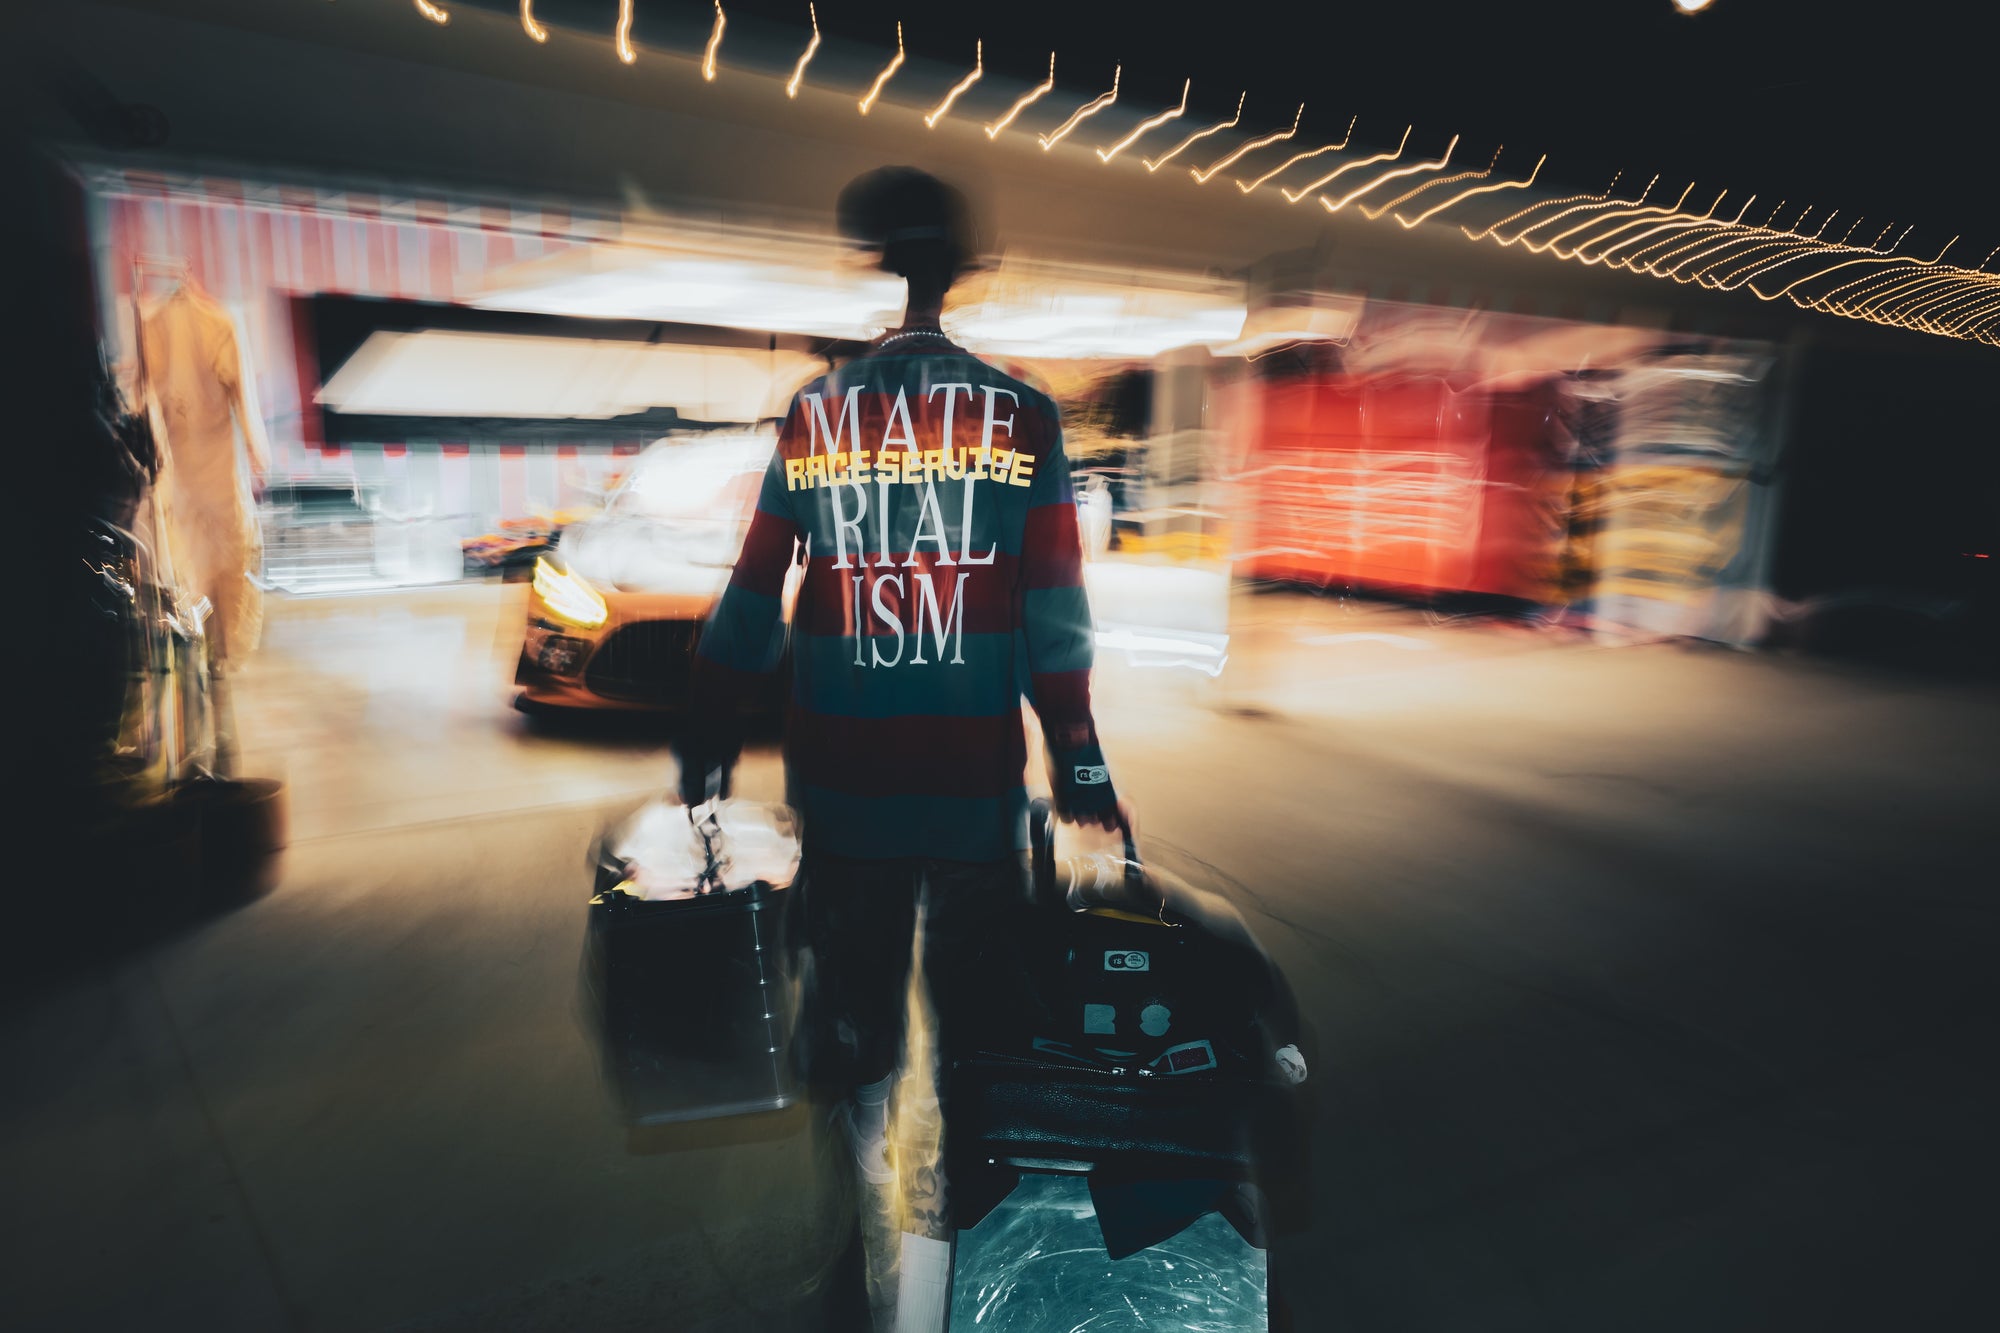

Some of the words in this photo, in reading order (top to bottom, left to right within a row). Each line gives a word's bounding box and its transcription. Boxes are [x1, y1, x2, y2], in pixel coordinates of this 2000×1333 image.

[804, 383, 1020, 474] MATE
[828, 473, 996, 569] RIAL
[852, 572, 970, 668] ISM
